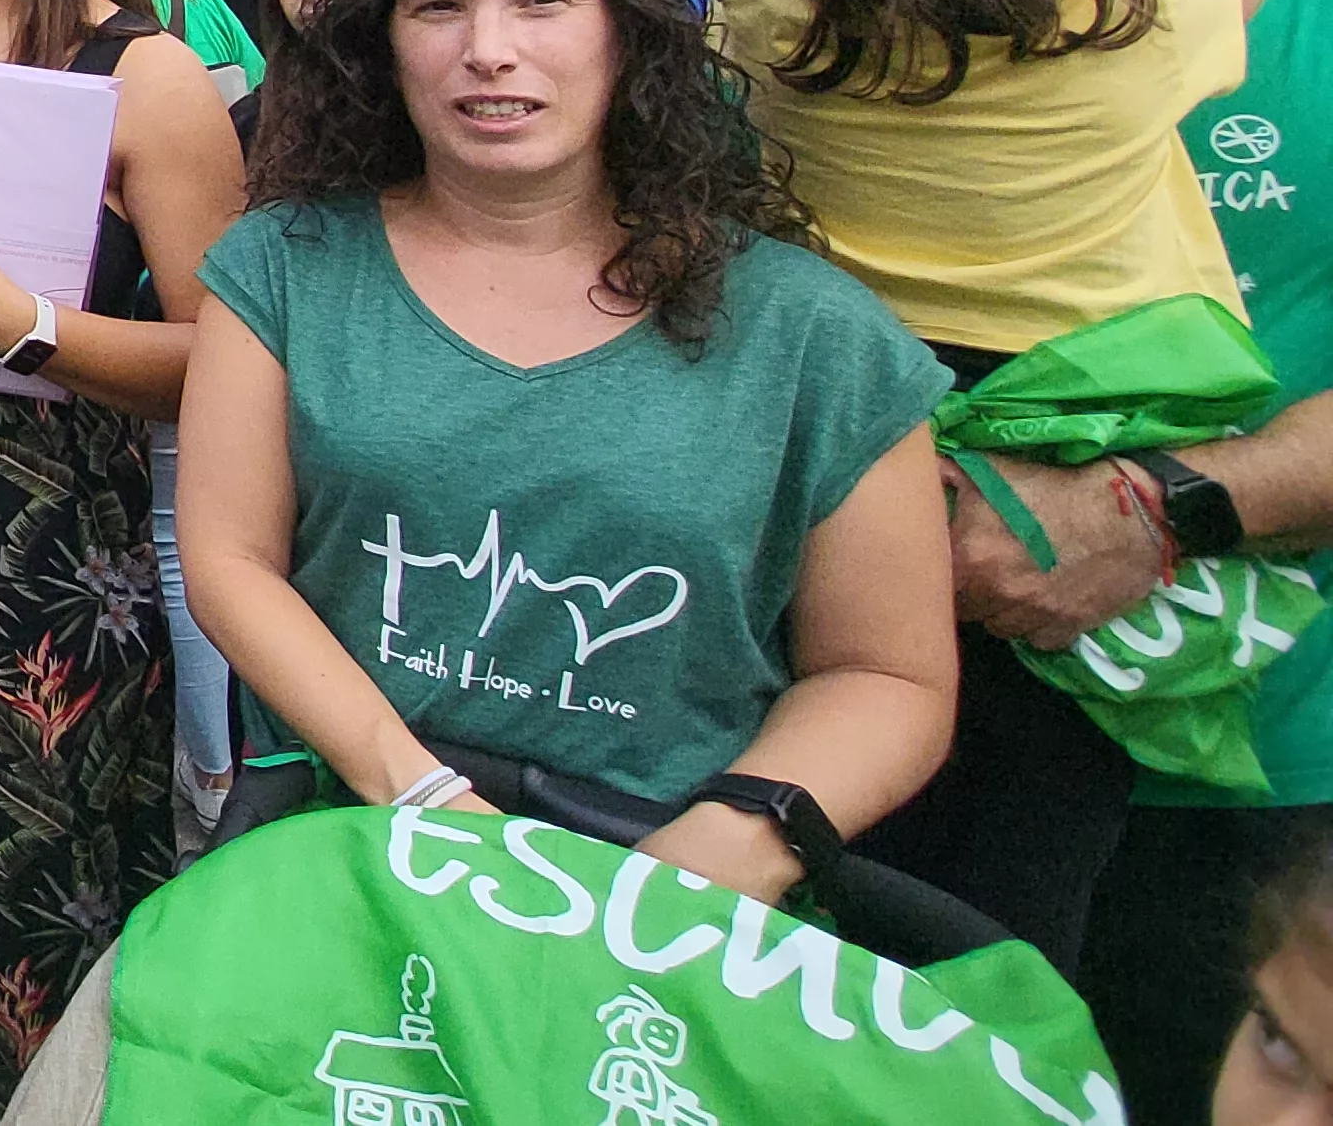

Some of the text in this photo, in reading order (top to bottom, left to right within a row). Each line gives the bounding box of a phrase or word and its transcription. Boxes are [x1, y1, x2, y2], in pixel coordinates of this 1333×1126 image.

[1197, 170, 1297, 212] ICA
[377, 623, 637, 719] Faith Hope Love
